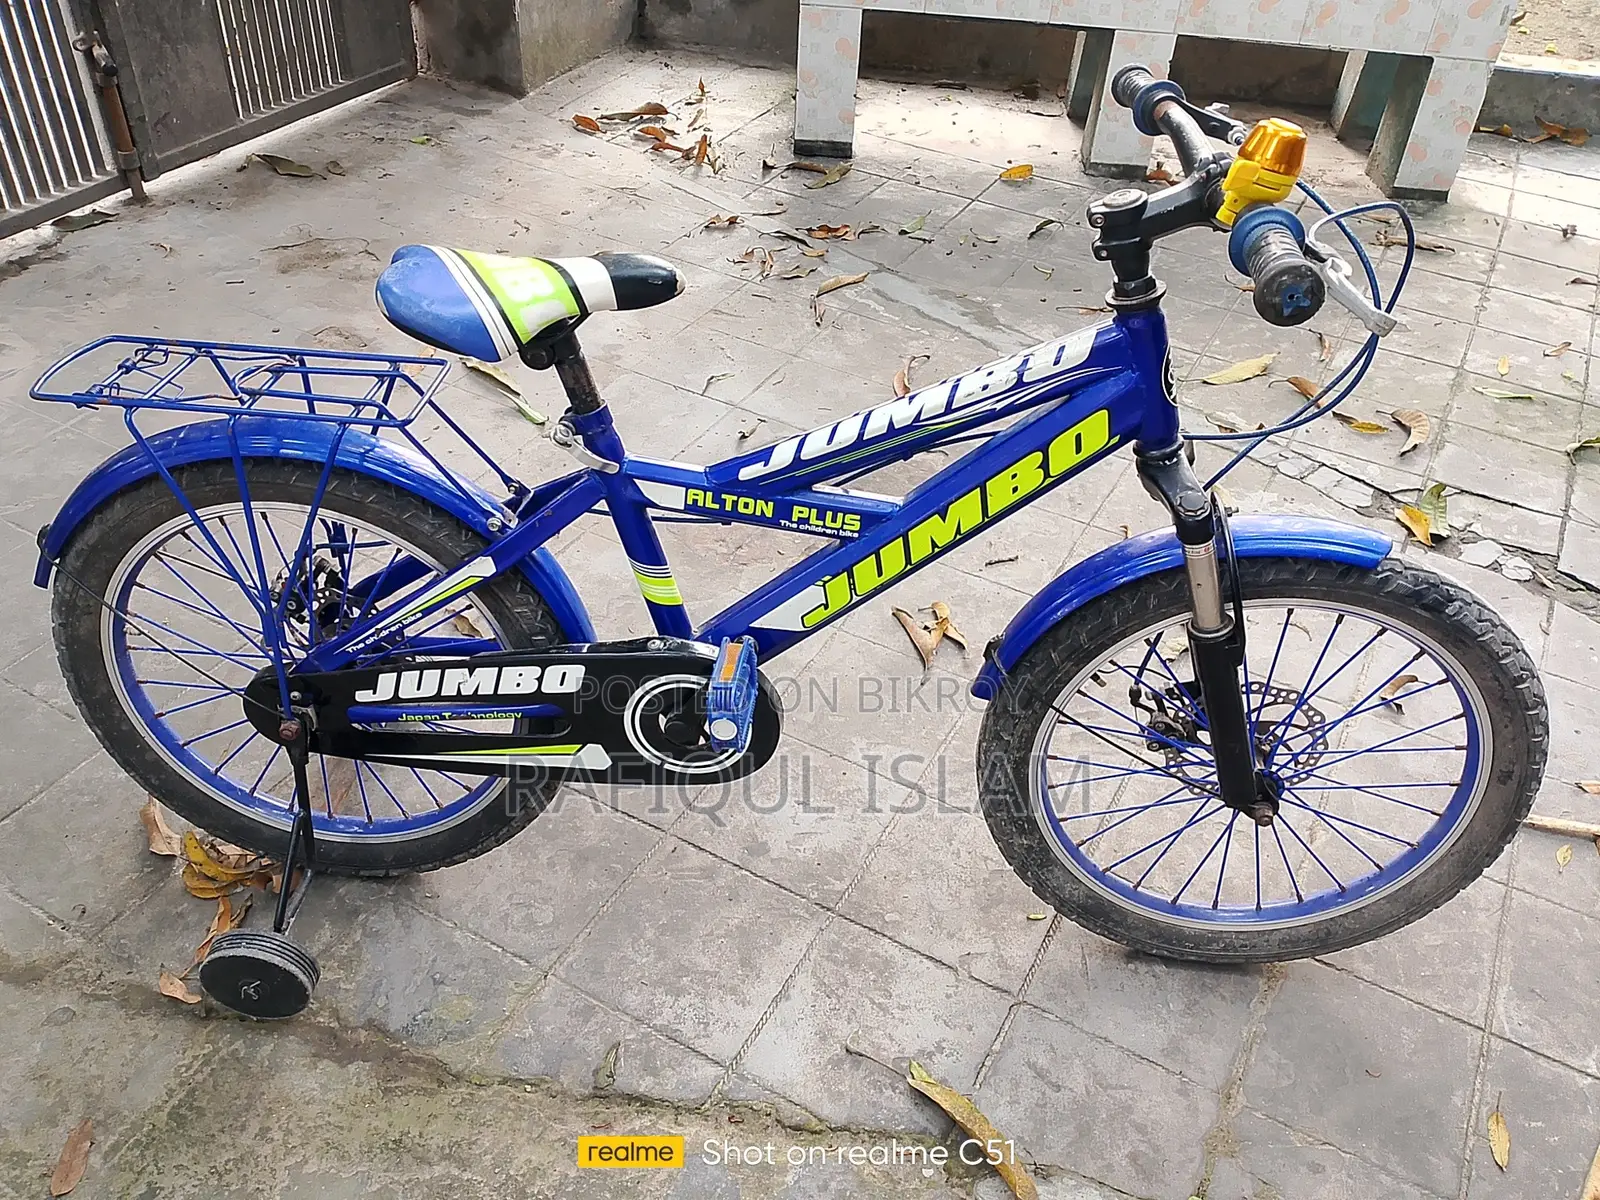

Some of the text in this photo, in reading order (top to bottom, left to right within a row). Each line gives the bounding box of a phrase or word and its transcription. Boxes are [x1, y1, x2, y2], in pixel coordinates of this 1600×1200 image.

[738, 329, 1098, 481] JUMBO
[687, 488, 861, 531] ALTON PLUS
[779, 519, 859, 538] The children bike
[801, 408, 1110, 628] JUMBO
[345, 612, 423, 653] The chdren bike
[355, 664, 586, 702] JUMBO
[397, 712, 440, 721] Japan
